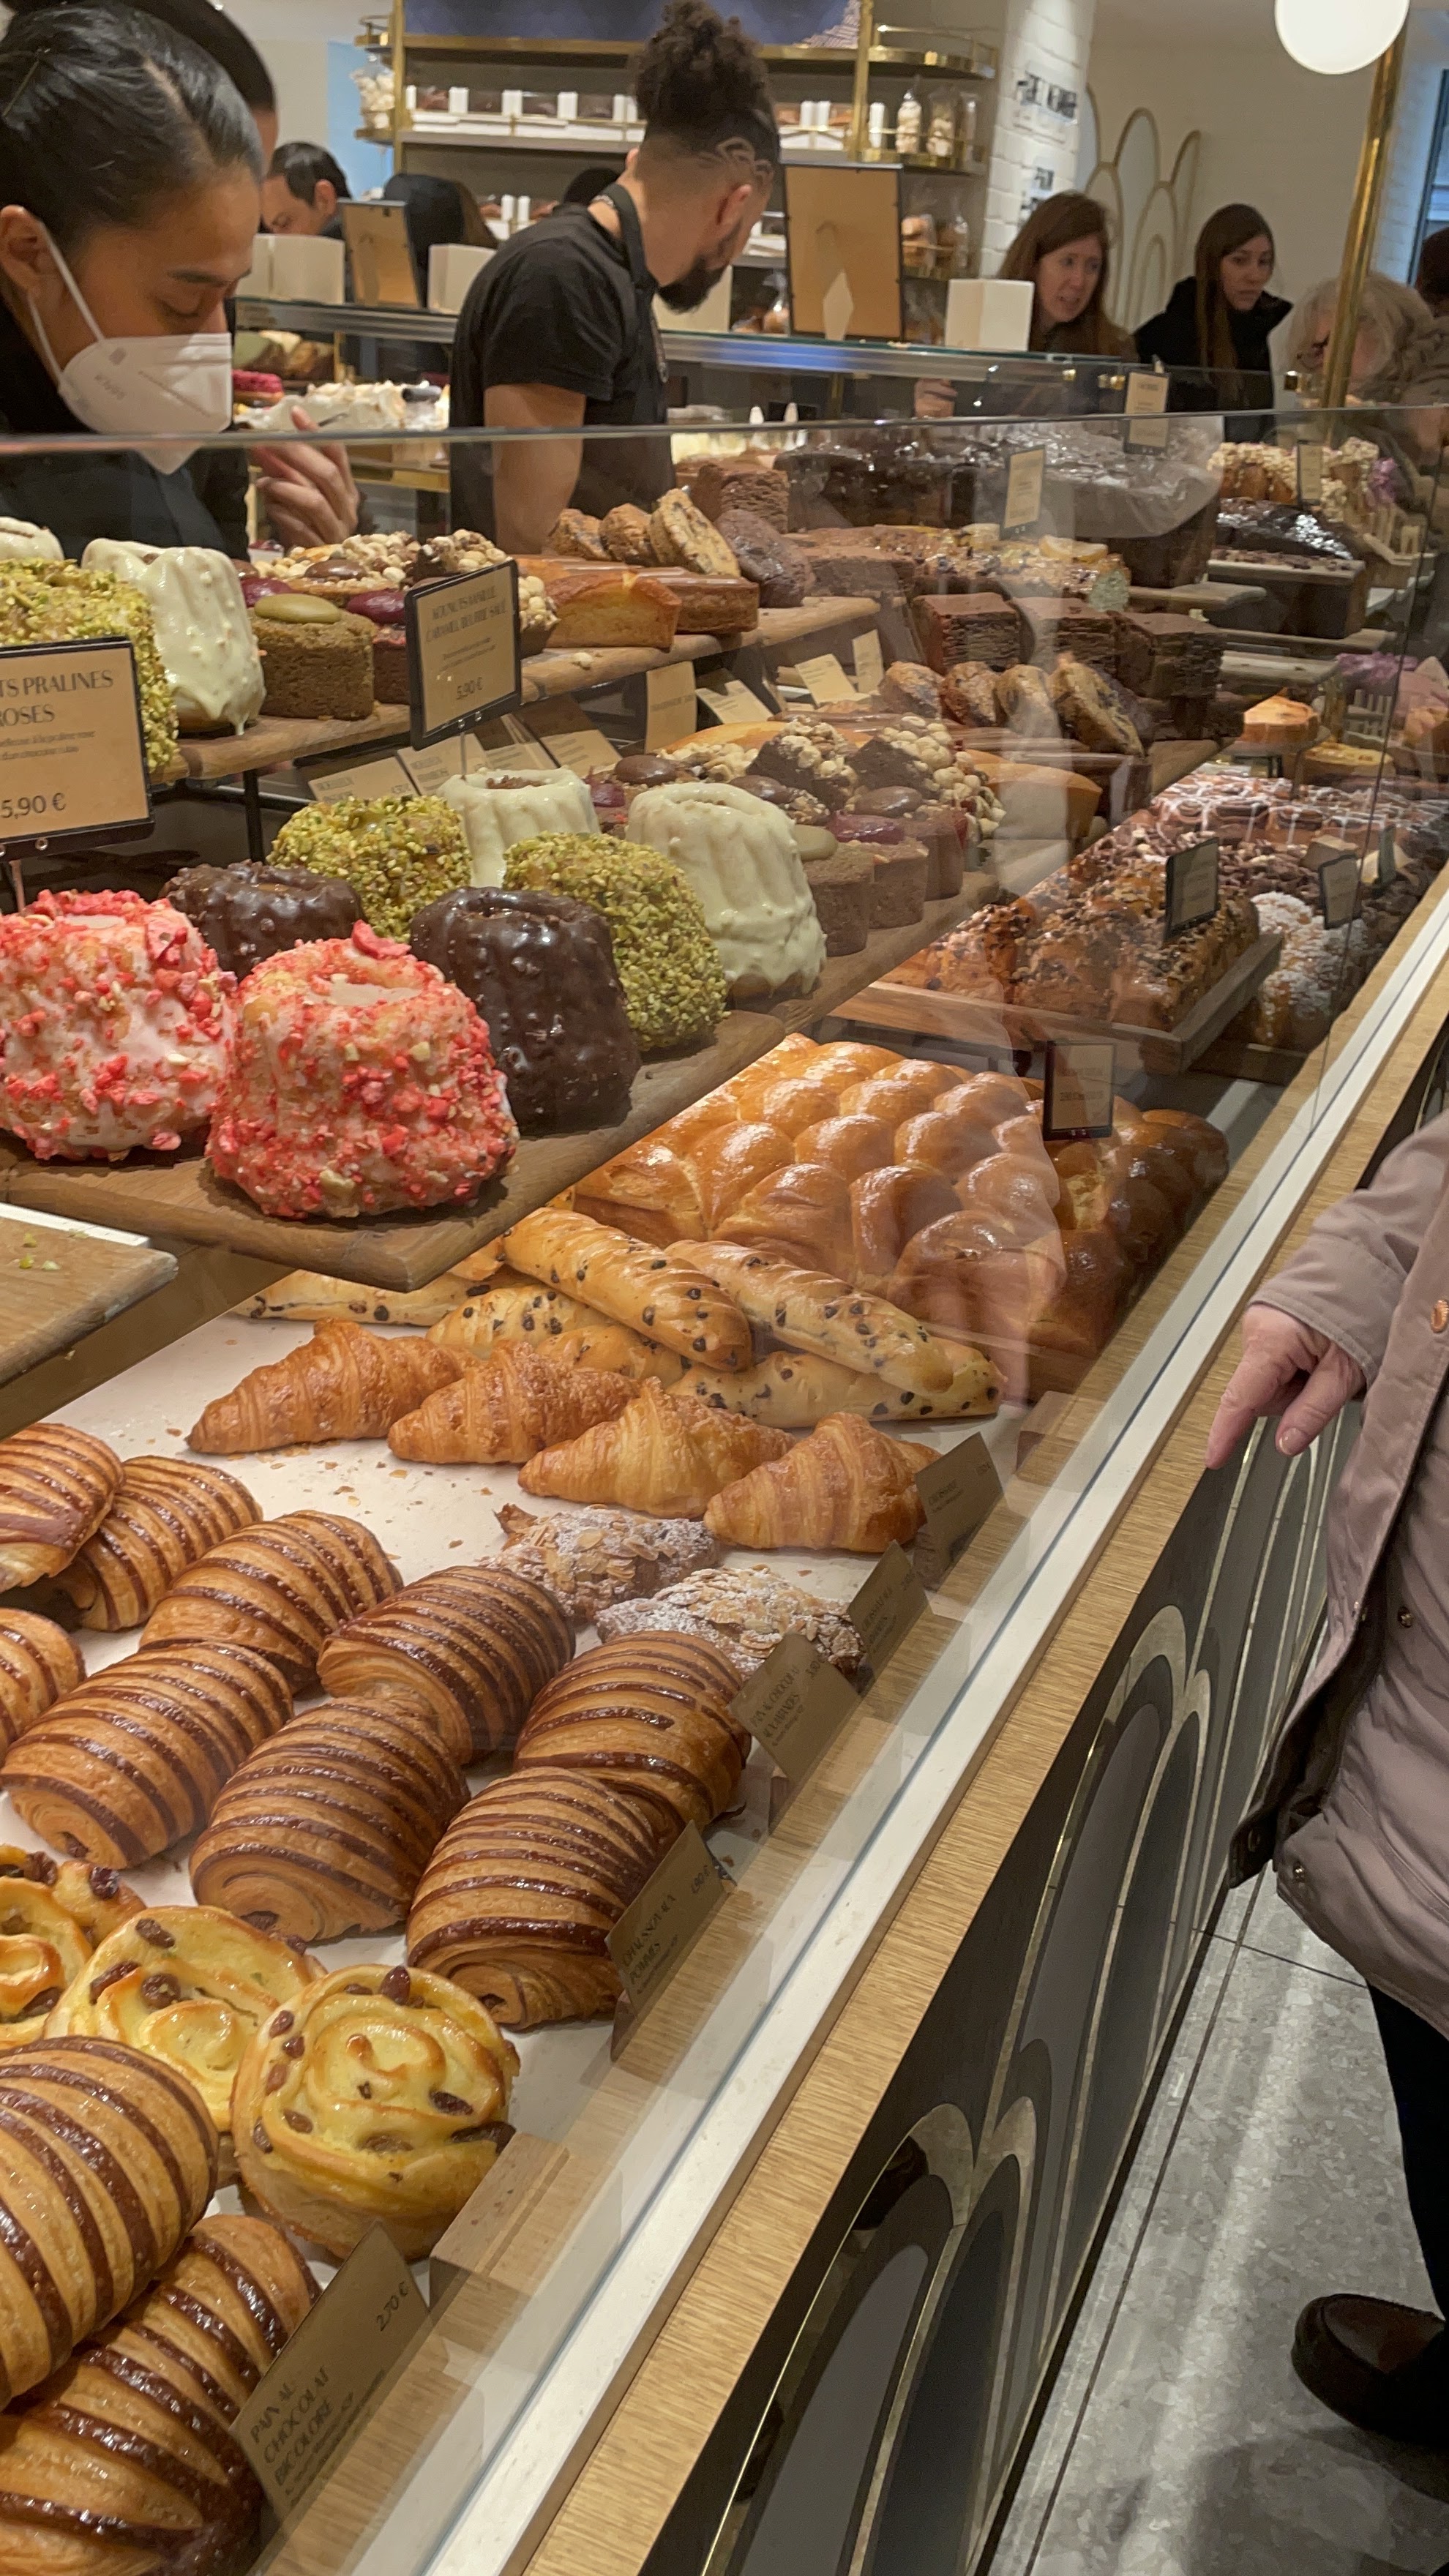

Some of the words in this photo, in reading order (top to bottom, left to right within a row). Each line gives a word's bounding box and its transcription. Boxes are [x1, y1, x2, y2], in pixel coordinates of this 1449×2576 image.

[23, 670, 114, 695] PRALINES
[0, 795, 47, 820] 5,90
[52, 793, 67, 812] €
[263, 2365, 330, 2465] CHOCOLAT
